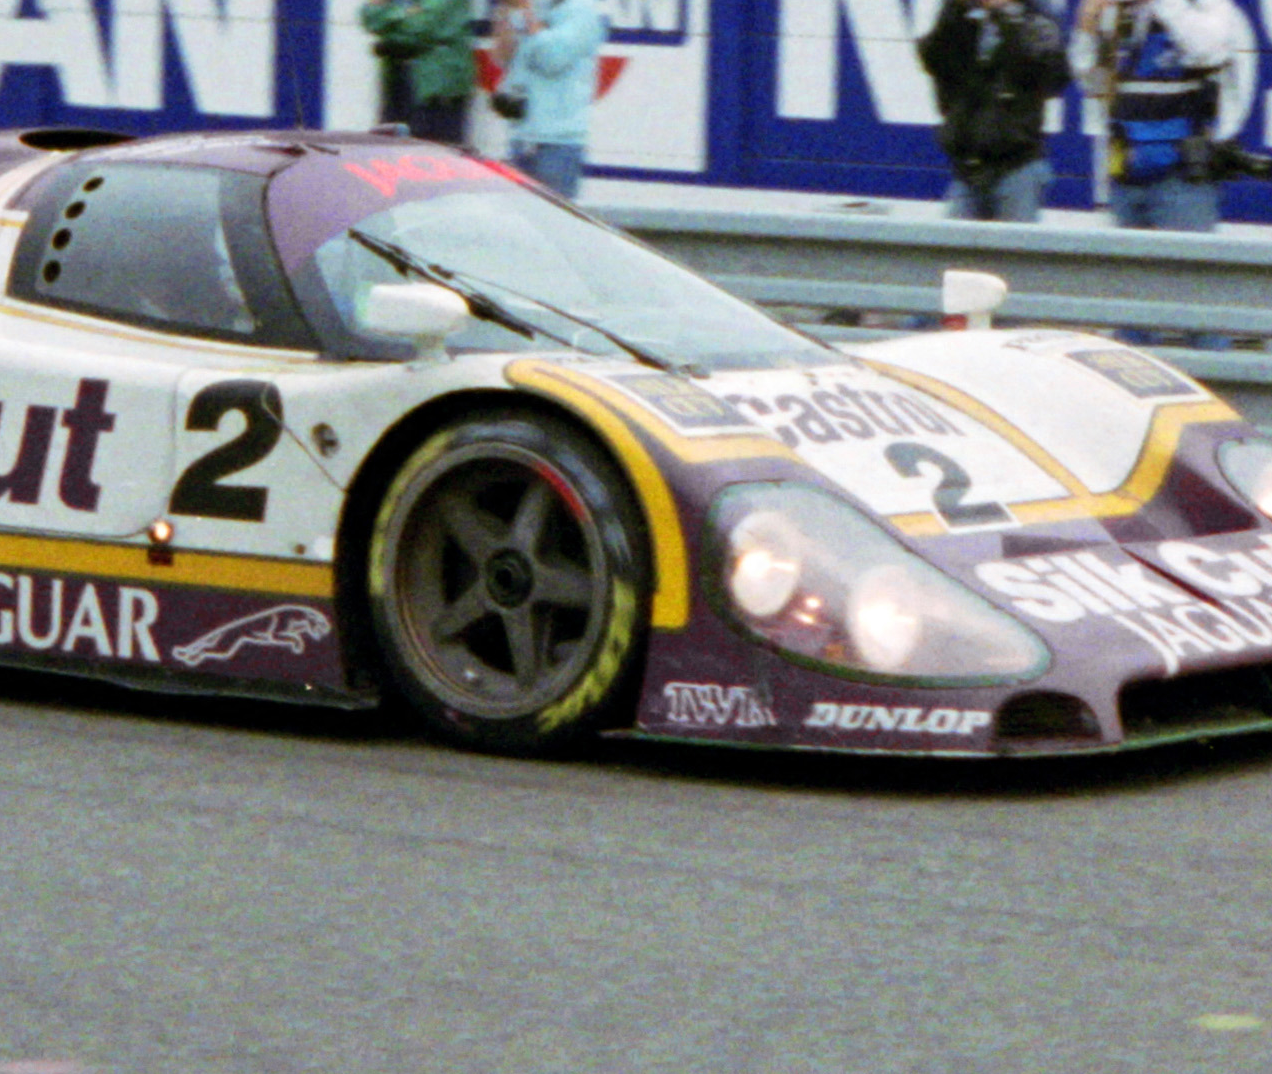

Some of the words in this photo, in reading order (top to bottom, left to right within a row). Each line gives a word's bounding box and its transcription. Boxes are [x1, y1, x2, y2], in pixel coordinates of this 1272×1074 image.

[169, 379, 283, 522] 2
[724, 383, 967, 449] Castrol
[884, 442, 1013, 528] 2
[974, 552, 1191, 623] Silk
[803, 702, 993, 735] DUNLOP
